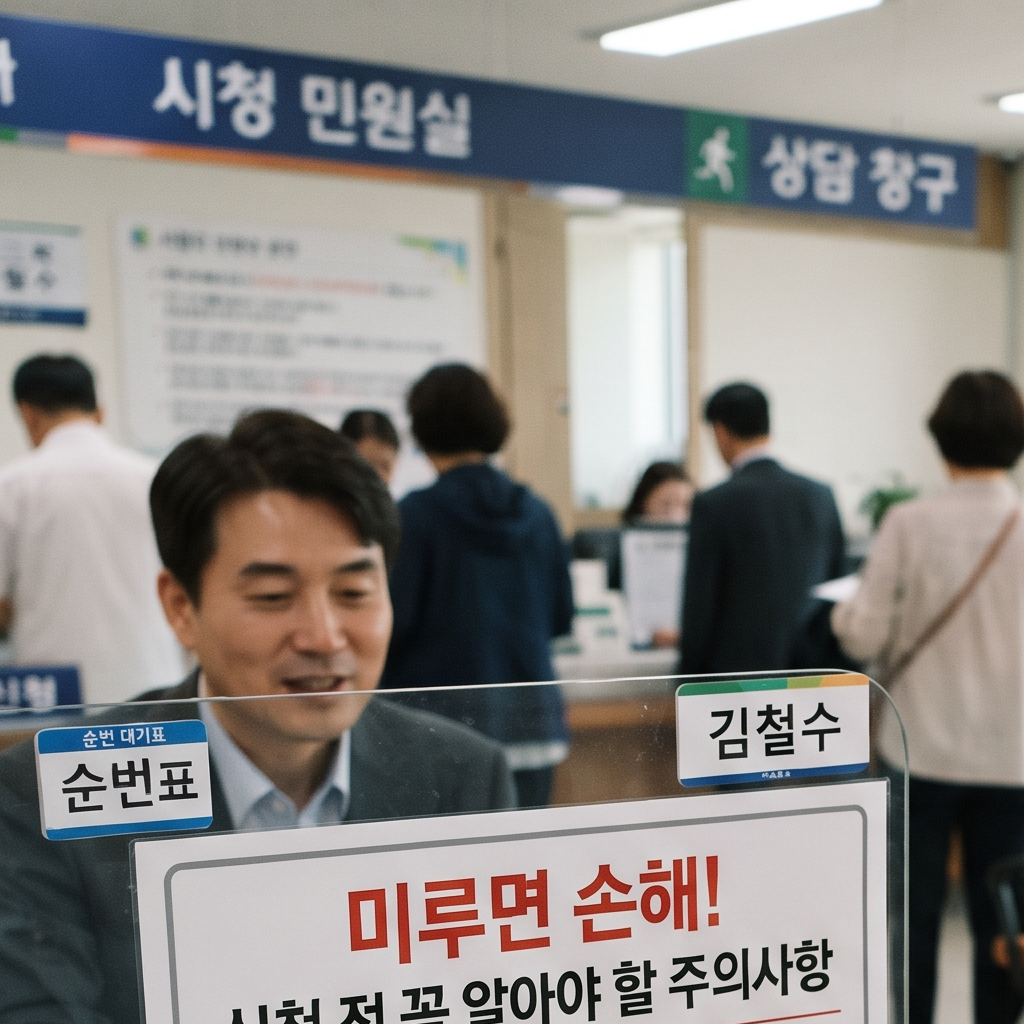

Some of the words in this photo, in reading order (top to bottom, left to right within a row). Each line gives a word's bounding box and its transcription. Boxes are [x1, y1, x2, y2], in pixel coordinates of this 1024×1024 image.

[153, 56, 276, 139] 시청
[301, 75, 472, 159] 민원실
[763, 135, 858, 203] 상담
[869, 147, 959, 214] 창구
[82, 730, 115, 748] 순번
[120, 726, 167, 746] 대기표
[709, 702, 841, 760] 김철수
[61, 758, 199, 813] 순번표
[347, 869, 551, 964] 미루면
[573, 855, 720, 943] 손해!
[612, 960, 657, 1017] 할
[668, 938, 834, 1009] 주의사항
